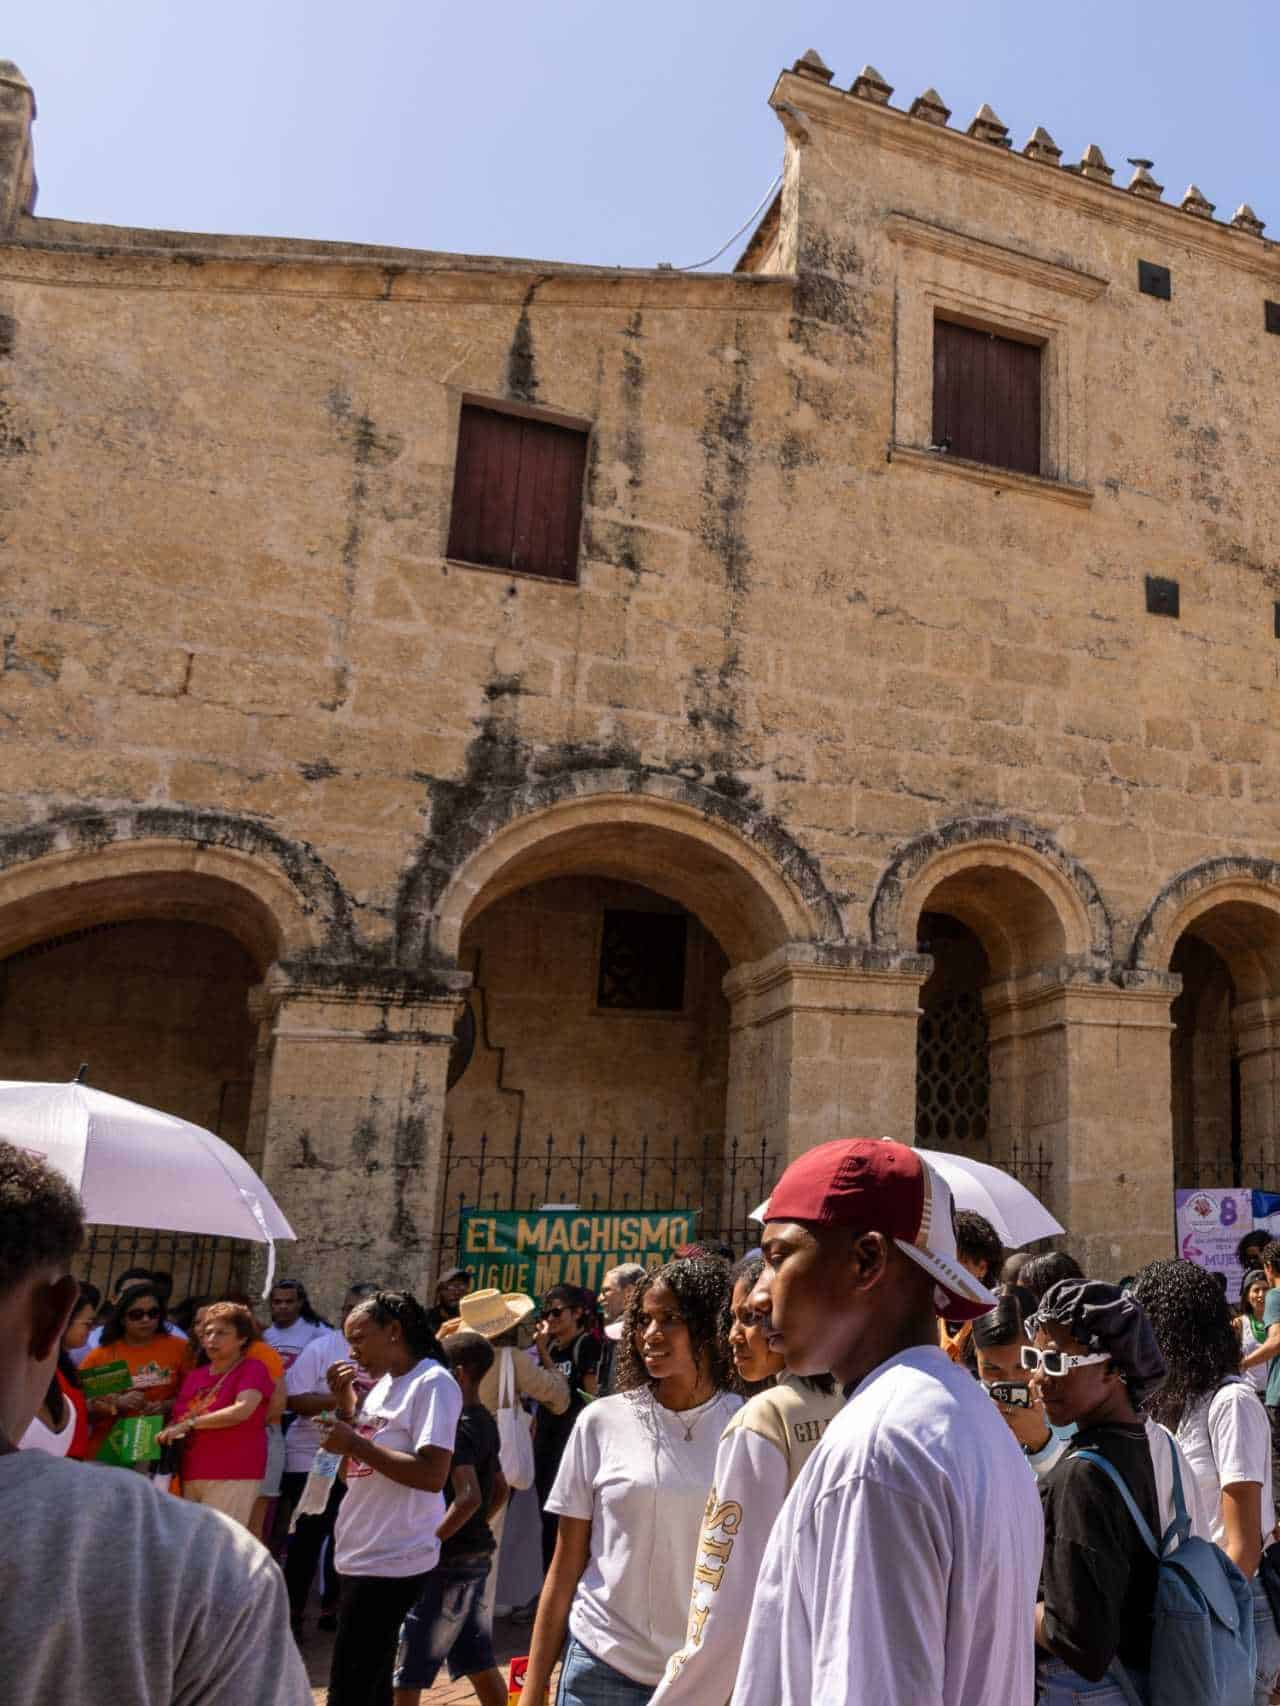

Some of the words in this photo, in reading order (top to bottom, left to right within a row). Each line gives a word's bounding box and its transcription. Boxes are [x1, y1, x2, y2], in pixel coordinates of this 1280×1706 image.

[1219, 1196, 1238, 1226] 8
[466, 1218, 507, 1253] EL
[516, 1217, 689, 1252] MACHISMO
[465, 1263, 529, 1294] SIGUE
